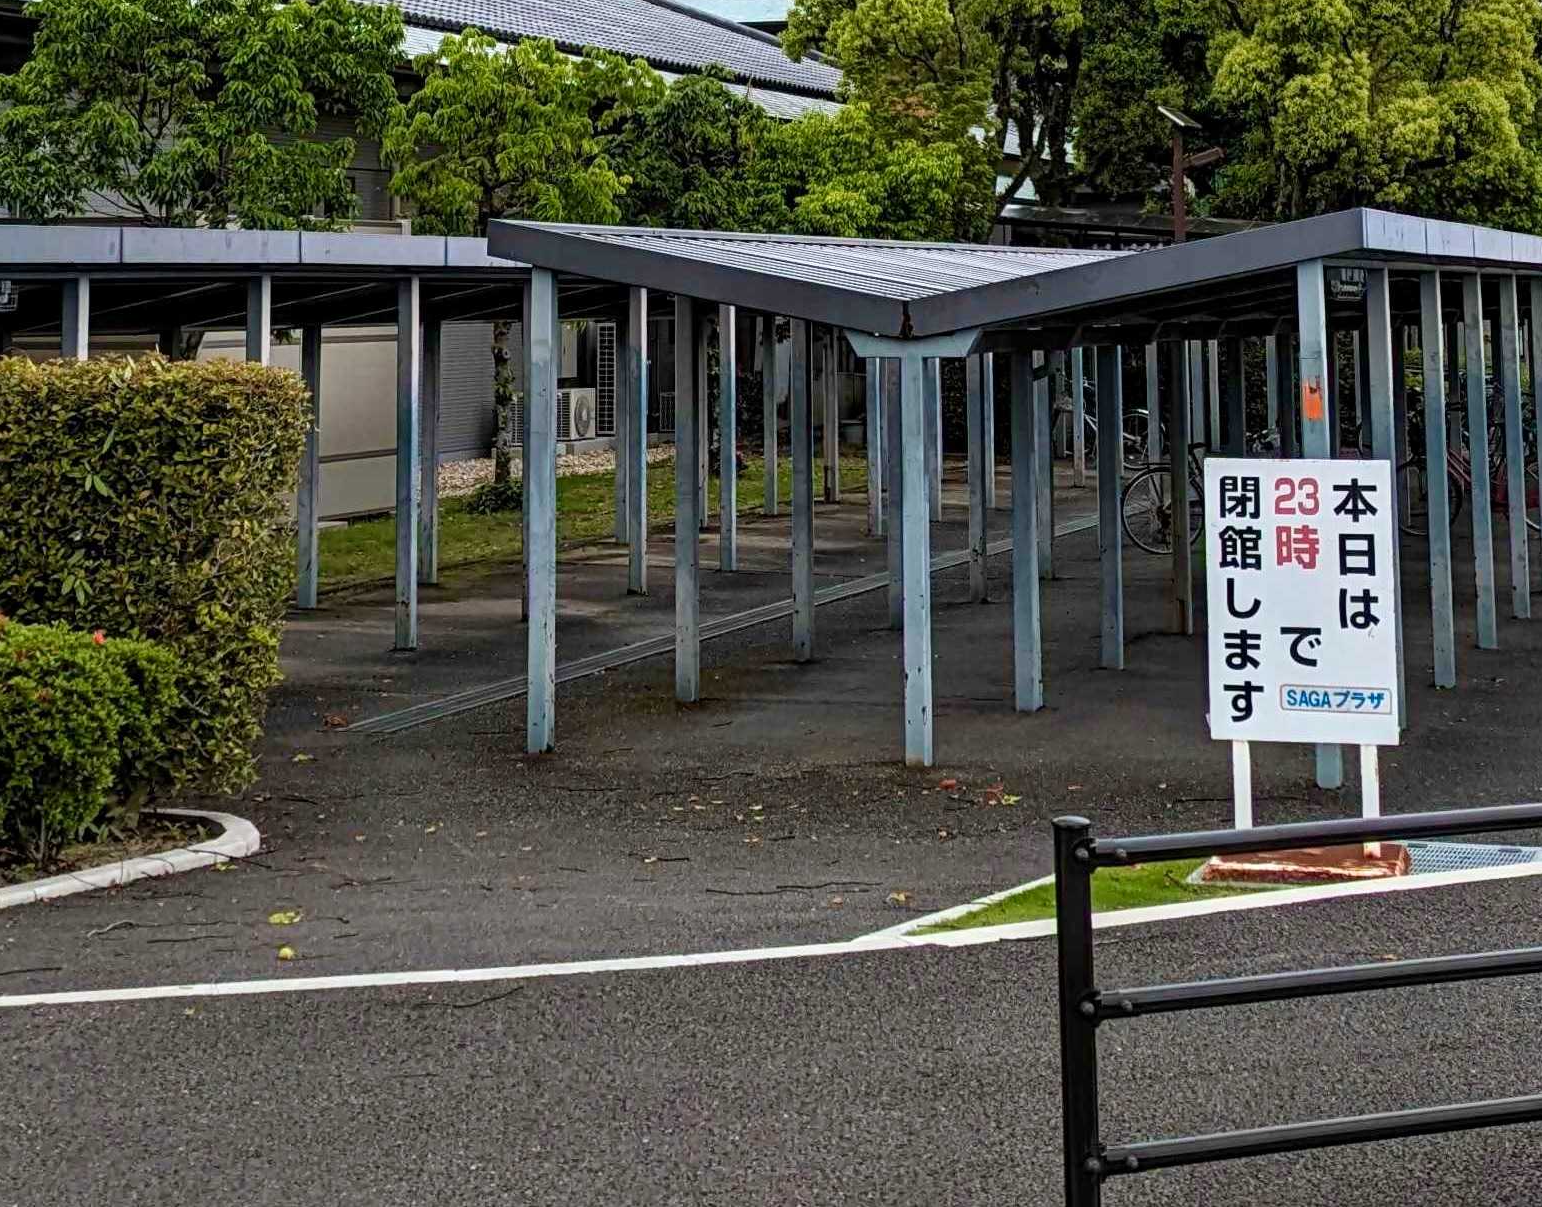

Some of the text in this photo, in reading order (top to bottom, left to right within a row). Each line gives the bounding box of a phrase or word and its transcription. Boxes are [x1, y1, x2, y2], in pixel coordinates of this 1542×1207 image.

[1218, 476, 1264, 722] 閉館します
[1332, 478, 1380, 630] 本日は
[1286, 689, 1385, 709] SAGAプラザ
